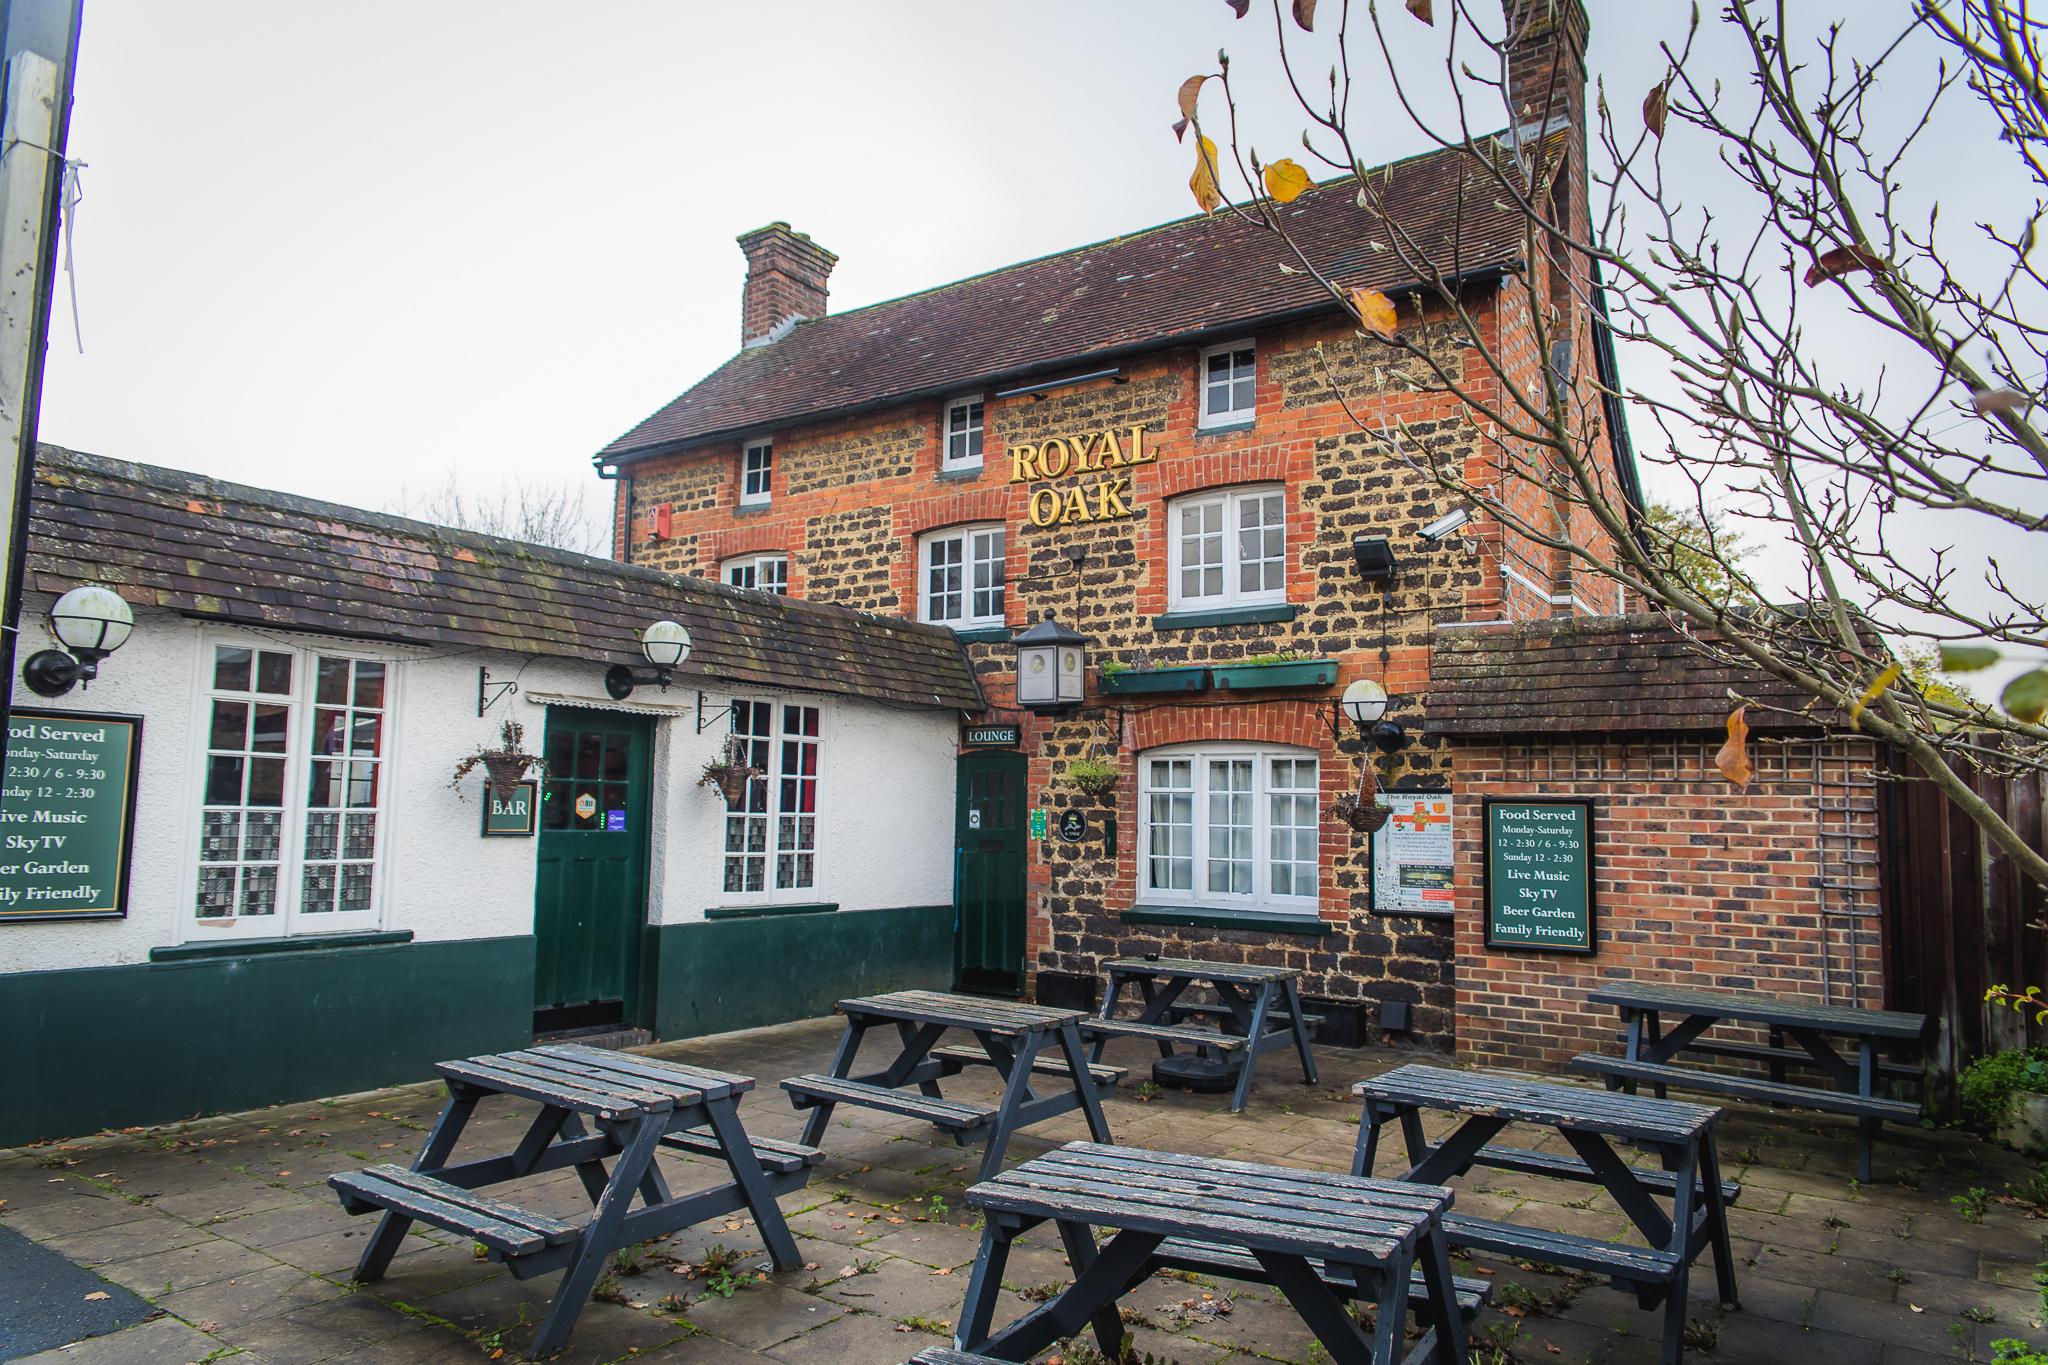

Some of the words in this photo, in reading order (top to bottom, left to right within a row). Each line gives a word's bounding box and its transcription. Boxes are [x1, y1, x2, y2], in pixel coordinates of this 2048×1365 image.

[1009, 425, 1159, 483] ROYAL
[1029, 478, 1132, 527] OAK
[7, 725, 35, 739] od
[40, 726, 105, 742] Served
[969, 730, 1014, 742] LOUNGE
[9, 767, 39, 778] 2:30
[55, 769, 63, 779] 6
[76, 769, 106, 780] 9:30
[2, 787, 32, 802] nday
[38, 788, 52, 798] 12
[65, 788, 95, 799] 2:30
[492, 800, 526, 816] BAR
[1, 810, 28, 823] ive
[32, 811, 87, 823] Music
[1499, 809, 1530, 820] Food
[1533, 810, 1576, 821] Served
[1502, 825, 1573, 837] Monday-Saturday
[6, 836, 39, 853] Sky
[41, 836, 67, 849] TV
[1498, 839, 1507, 847] 12
[1516, 840, 1535, 848] 2:30
[1545, 840, 1551, 848] 6
[1559, 840, 1579, 849] 9:30
[1503, 853, 1532, 864] Sunday
[1535, 854, 1545, 862] 12
[0, 864, 20, 874] er
[24, 861, 89, 874] Garden
[1507, 870, 1531, 880] Live
[1534, 871, 1570, 881] Music
[0, 888, 22, 905] ily
[26, 885, 101, 903] Friendly
[1519, 888, 1540, 901] Sky
[1541, 889, 1558, 898] TV
[1503, 906, 1529, 916] Beer
[1532, 906, 1575, 918] Garden
[1495, 924, 1533, 938] Family
[1536, 926, 1584, 941] Friendly
